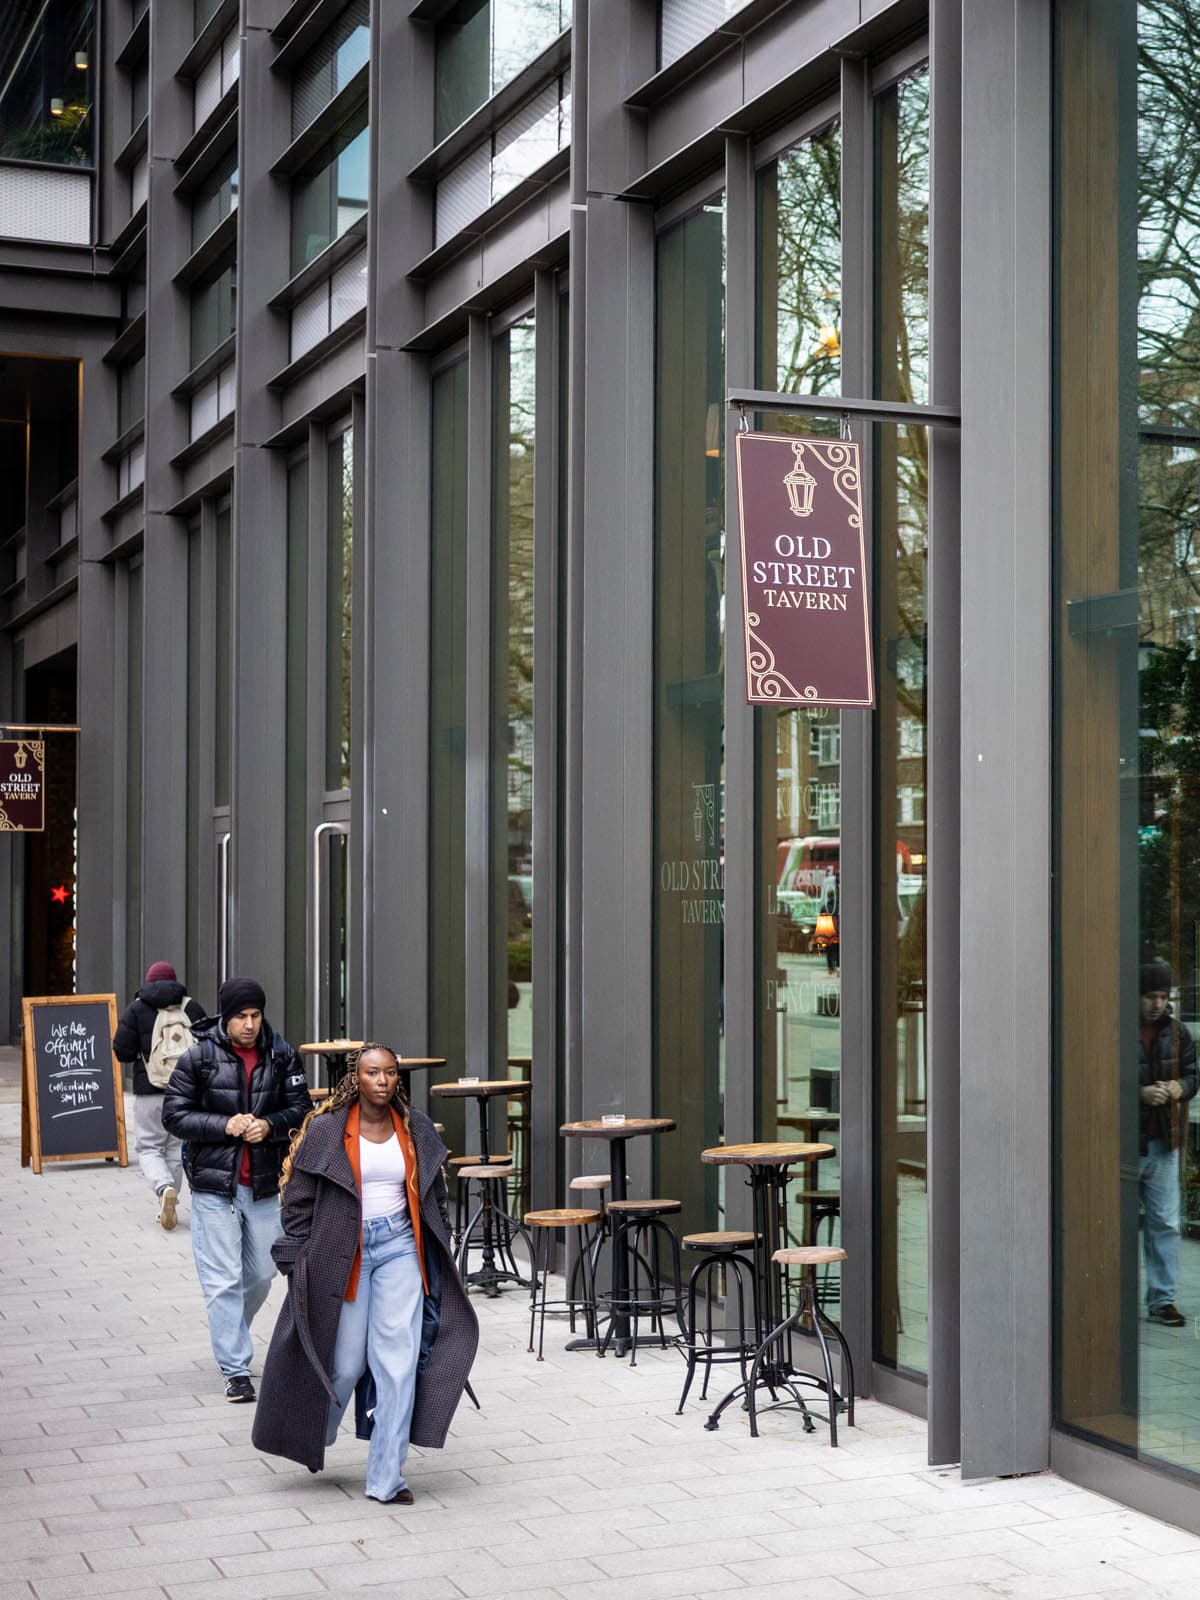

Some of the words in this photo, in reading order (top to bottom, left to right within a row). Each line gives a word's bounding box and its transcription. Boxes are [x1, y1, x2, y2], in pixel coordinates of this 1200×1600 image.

[775, 534, 832, 560] OLD
[753, 561, 856, 589] STREET
[763, 588, 848, 611] TAVERN
[0, 783, 41, 793] STREET
[9, 773, 32, 783] OLD
[4, 792, 37, 801] TAVERN
[661, 860, 690, 891] OLD
[681, 899, 725, 924] TAVERN
[766, 979, 841, 1016] FUNCTIO
[51, 1023, 69, 1037] WE
